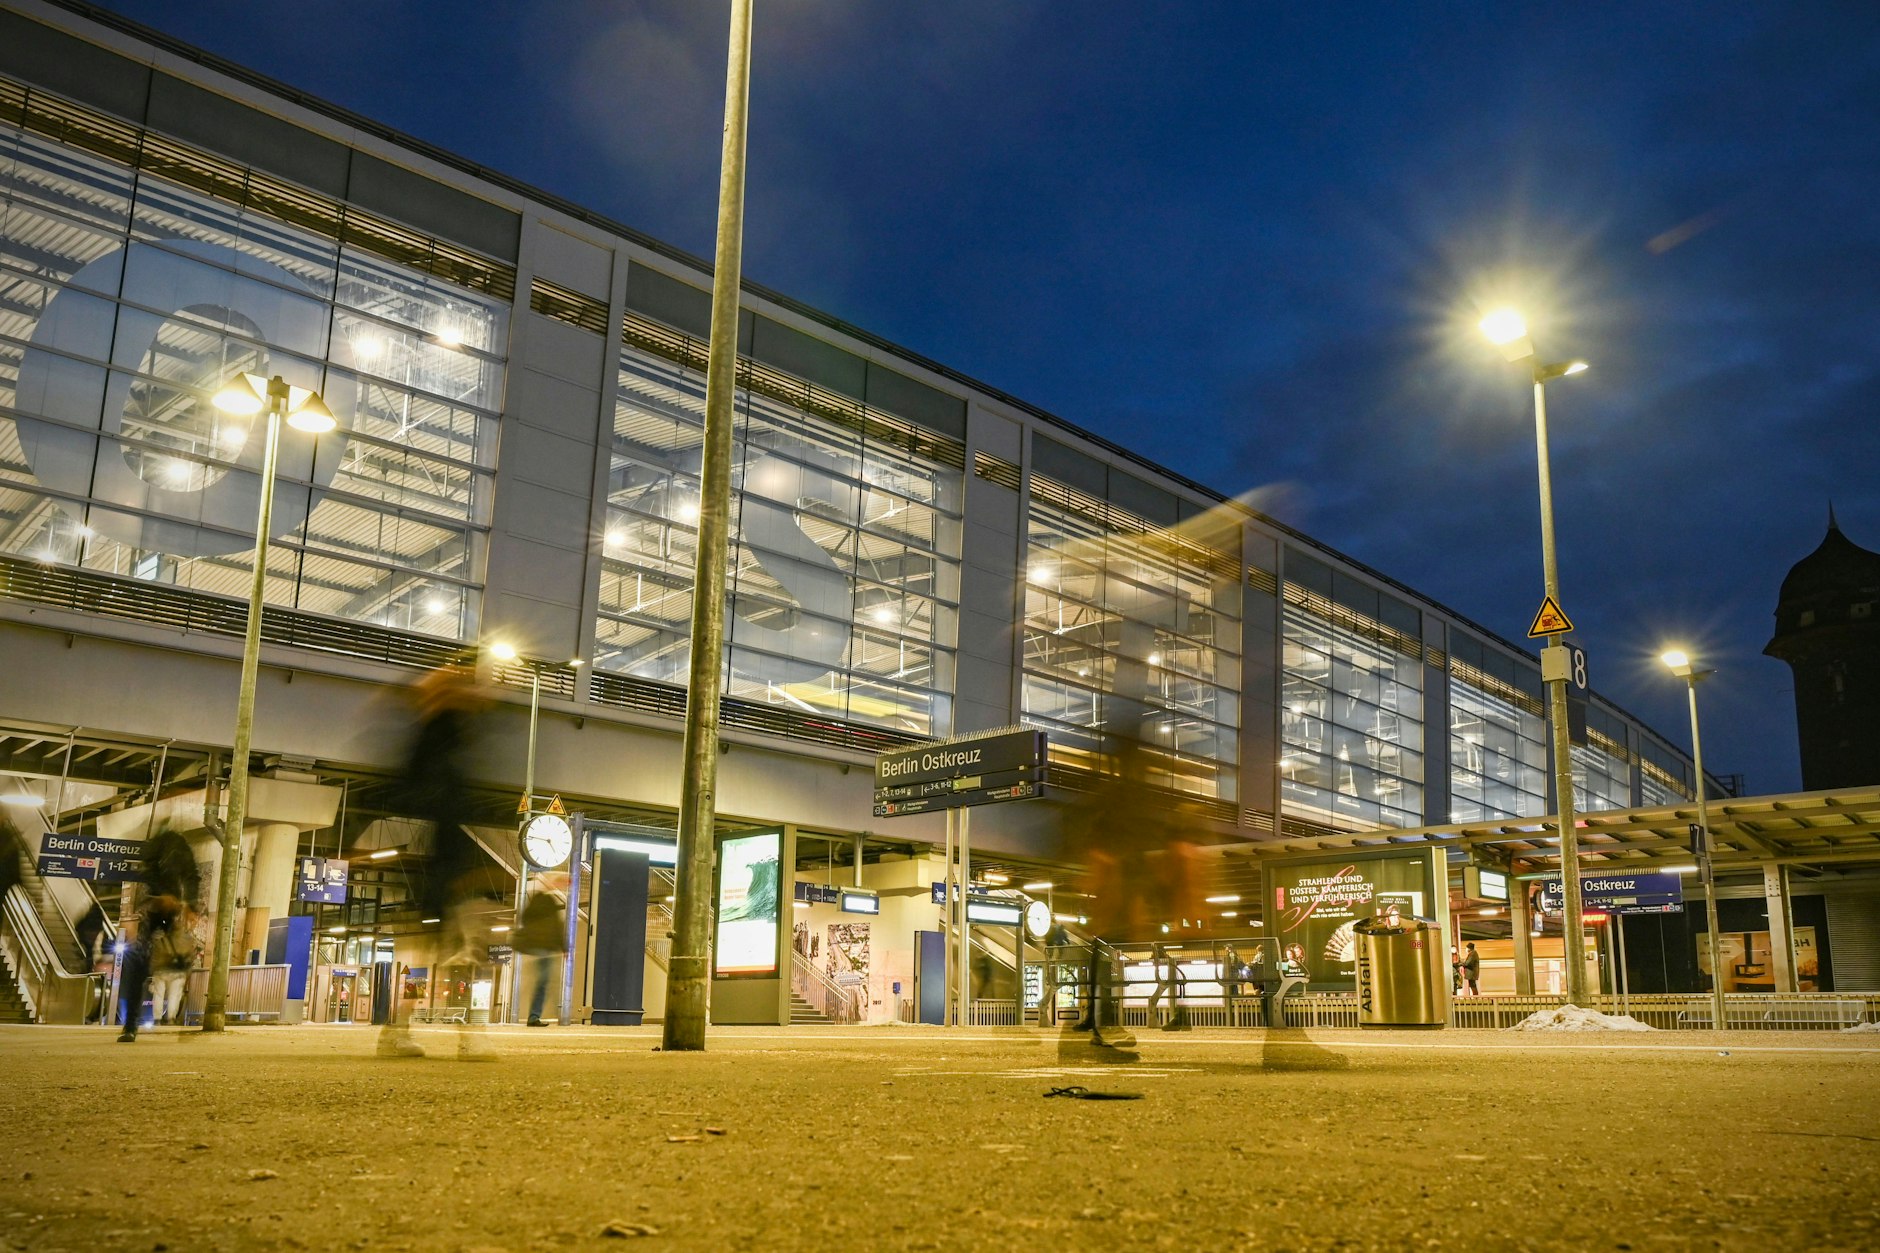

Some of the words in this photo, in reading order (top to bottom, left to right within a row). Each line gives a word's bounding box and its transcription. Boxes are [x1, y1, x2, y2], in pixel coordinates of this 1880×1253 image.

[1574, 649, 1587, 690] 8
[881, 759, 919, 778] Berlin
[922, 749, 982, 771] Ostkreuz
[48, 837, 84, 851] Berlin
[88, 840, 141, 855] Ostkreuz
[108, 861, 128, 872] 1-12
[1298, 876, 1343, 887] STRAHLEND
[1344, 875, 1363, 884] UND
[1584, 880, 1636, 892] Ostkreuz
[306, 883, 324, 892] 13-14
[1321, 882, 1374, 894] KÄMPFERISCH
[1291, 895, 1309, 904] UND
[1310, 891, 1372, 903] VERFÜHRERISCH
[1360, 957, 1372, 1013] Abfall
